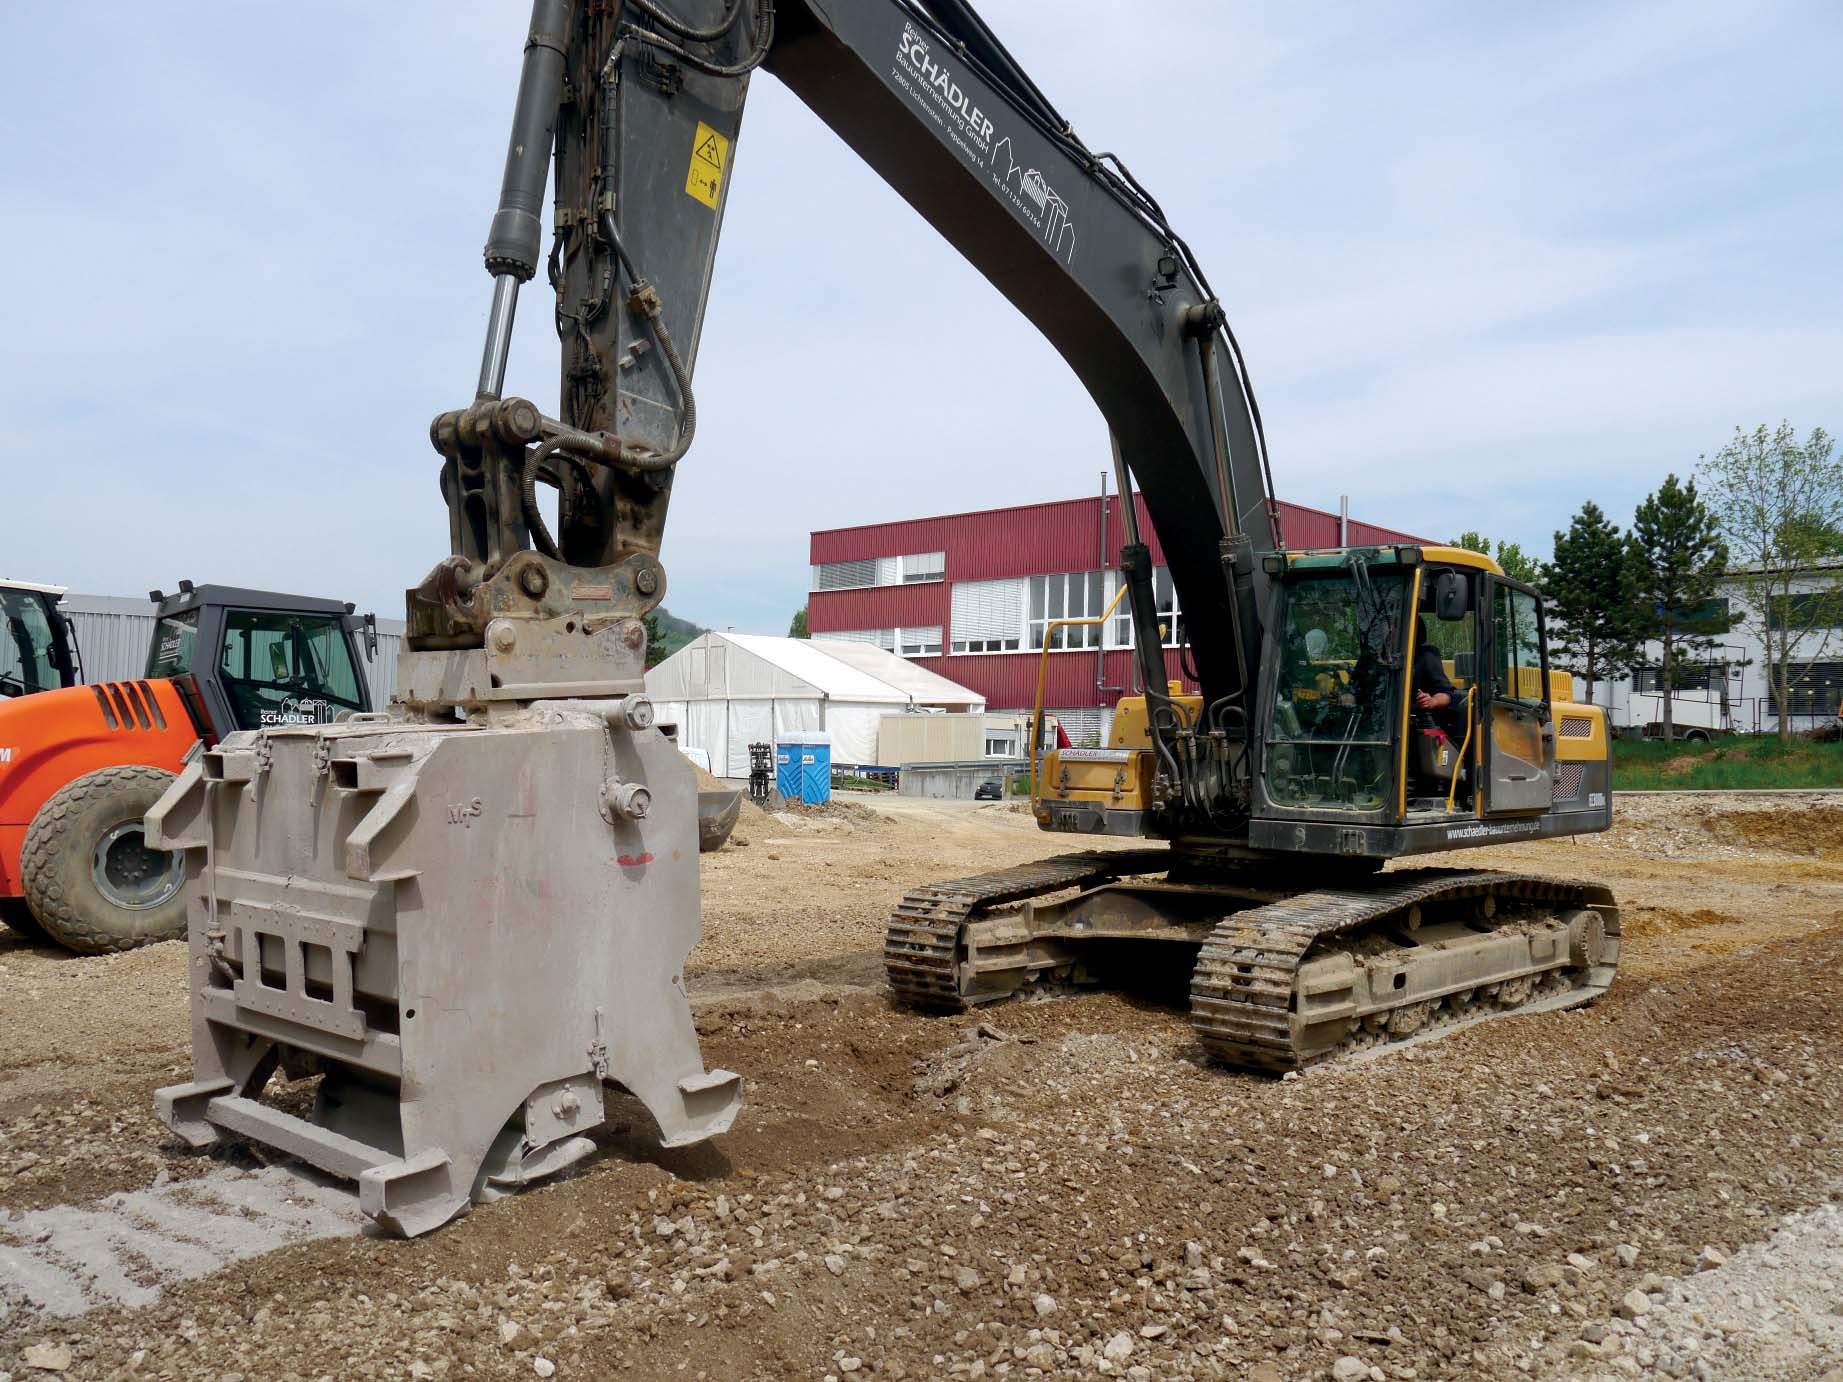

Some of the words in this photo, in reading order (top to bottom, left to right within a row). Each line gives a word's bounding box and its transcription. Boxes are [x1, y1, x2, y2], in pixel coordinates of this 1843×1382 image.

[904, 21, 930, 52] Reiner
[890, 67, 910, 91] 72805
[909, 87, 943, 127] Lichtenstein
[895, 51, 965, 131] Bauunternehmung
[965, 125, 989, 154] GmbH
[899, 32, 994, 143] SCHÄDLER
